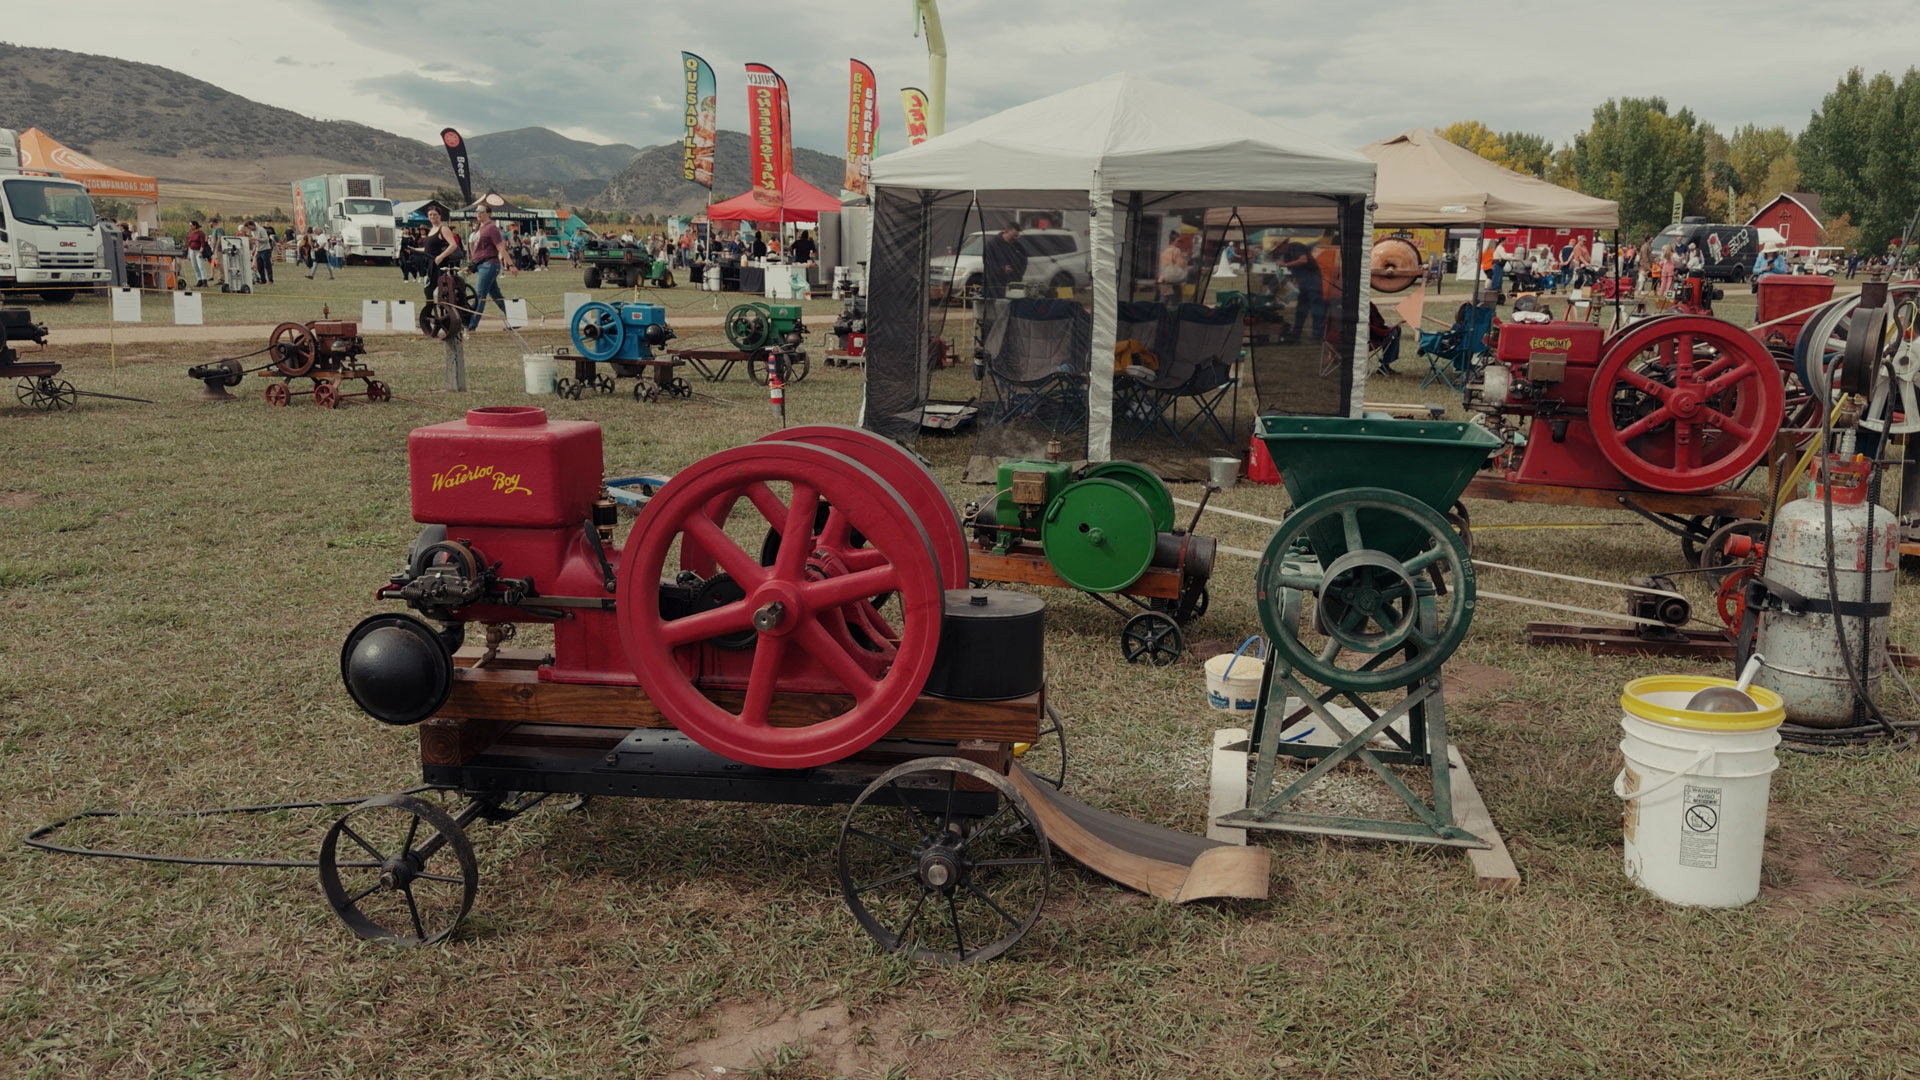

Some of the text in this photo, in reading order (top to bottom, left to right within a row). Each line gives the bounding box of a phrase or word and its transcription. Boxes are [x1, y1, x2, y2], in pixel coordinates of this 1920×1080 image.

[684, 58, 698, 181] QUESADILLAS
[849, 72, 863, 164] BREAKFAST
[860, 87, 873, 176] BURRITOS
[456, 156, 465, 178] Beer
[1533, 338, 1569, 349] ECONOMY
[431, 464, 533, 495] Waterloo Boy
[1692, 787, 1720, 795] WARNING
